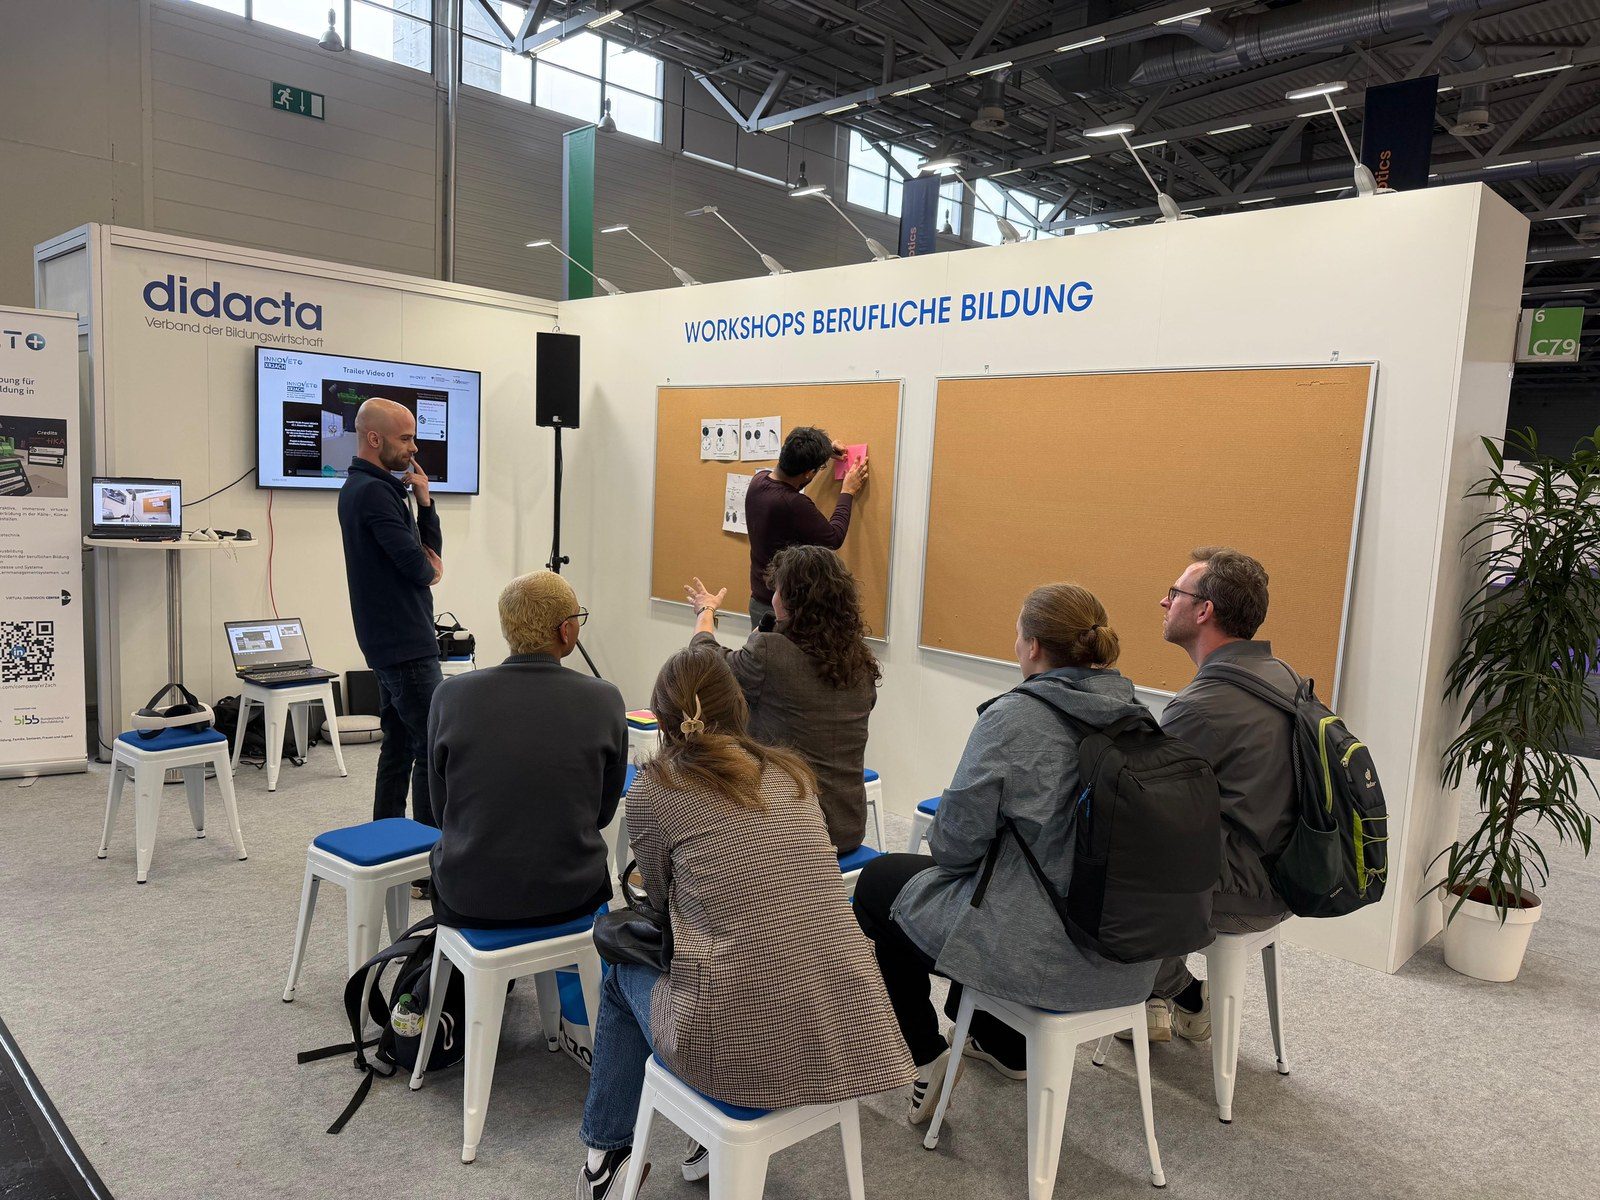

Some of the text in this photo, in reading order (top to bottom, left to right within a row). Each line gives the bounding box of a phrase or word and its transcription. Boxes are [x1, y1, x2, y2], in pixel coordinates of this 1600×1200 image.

[143, 274, 323, 331] didacta
[684, 281, 1094, 343] WORKSHOPS BERUFLICHE BILDUNG
[1534, 309, 1545, 322] 6
[144, 316, 324, 348] Verband der Bildungswirtschaft
[1532, 338, 1576, 356] C79
[343, 366, 365, 375] Trailer
[366, 369, 385, 377] Video
[22, 377, 35, 385] für
